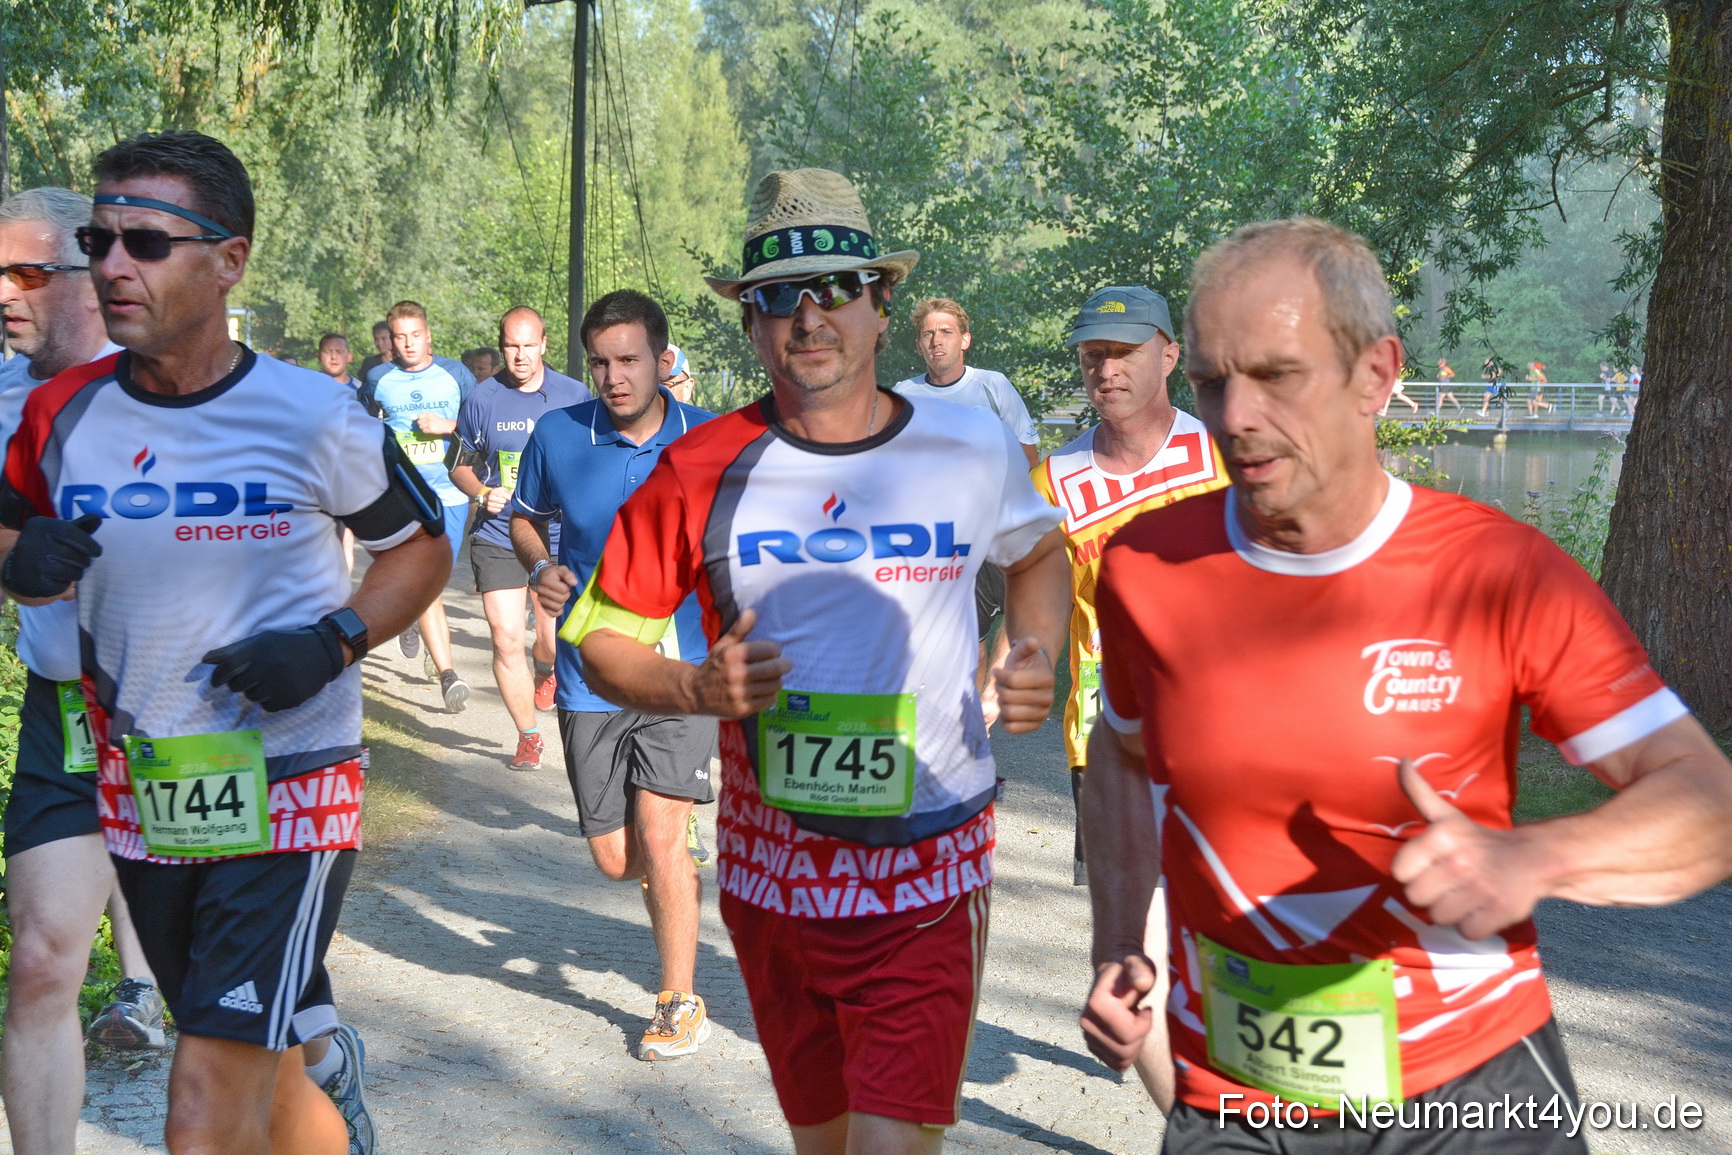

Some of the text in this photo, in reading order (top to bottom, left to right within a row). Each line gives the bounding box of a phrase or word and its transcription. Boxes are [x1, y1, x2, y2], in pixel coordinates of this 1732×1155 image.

[497, 421, 526, 431] EURO
[404, 441, 437, 456] 1770
[1361, 638, 1453, 673] Town &
[1363, 667, 1462, 715] Country
[1395, 698, 1442, 713] HAUS
[777, 733, 896, 781] 1745
[144, 775, 245, 822] 1744
[784, 778, 887, 795] Ebenhöch Martin
[190, 822, 247, 834] Wolfgang
[828, 846, 922, 881] AVIA
[726, 862, 786, 914] AVIA
[788, 879, 888, 918] AVIA
[893, 856, 983, 912] AVIA
[218, 996, 264, 1014] adidas
[1237, 1002, 1346, 1068] 542
[1290, 1067, 1342, 1084] Simon
